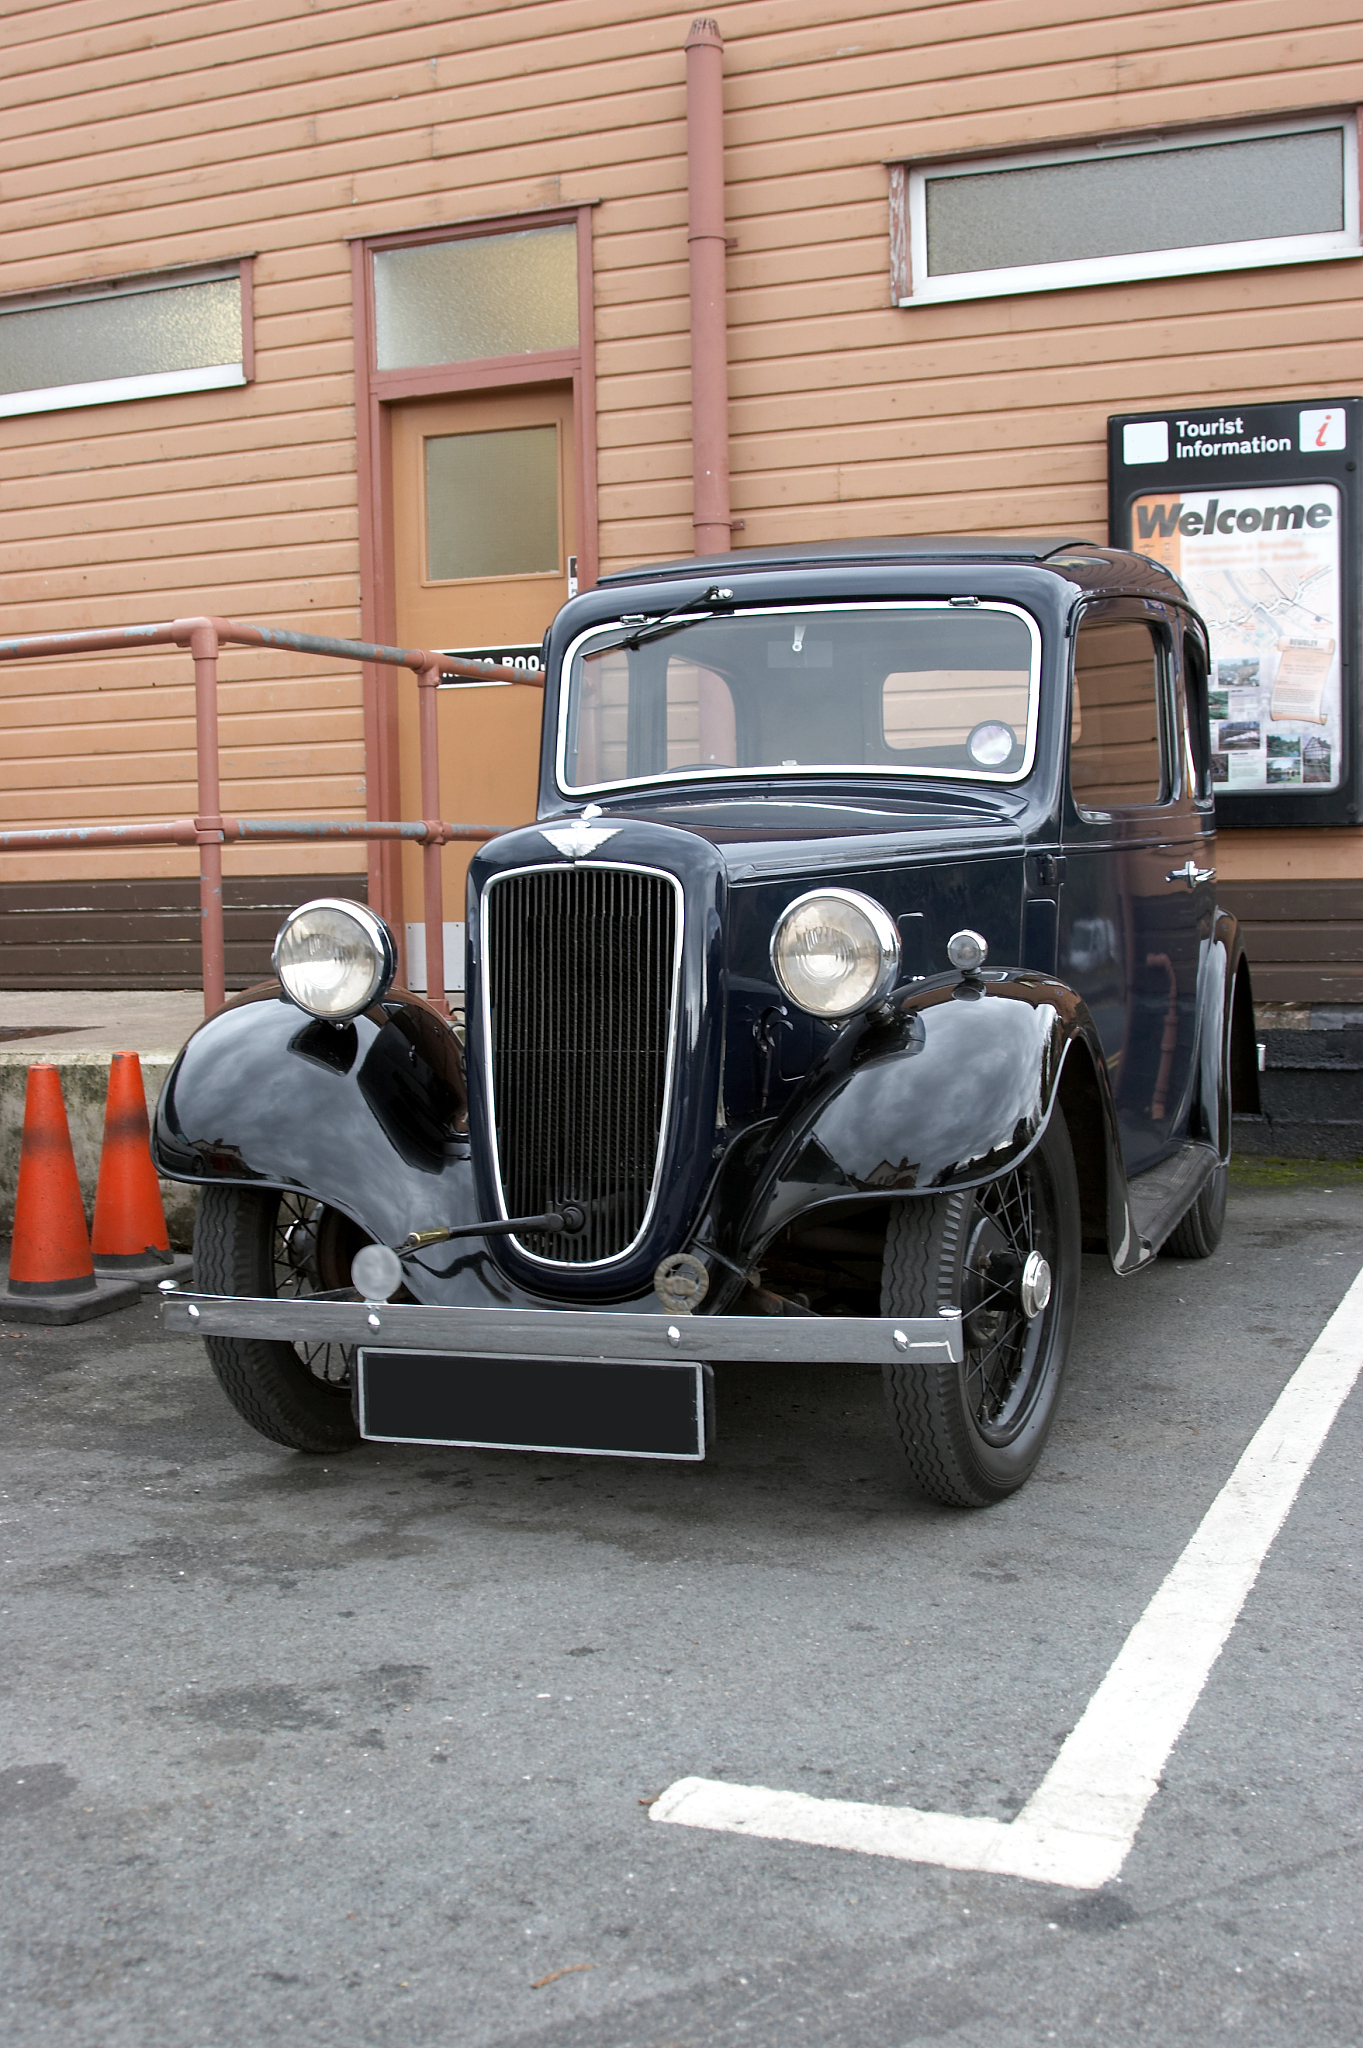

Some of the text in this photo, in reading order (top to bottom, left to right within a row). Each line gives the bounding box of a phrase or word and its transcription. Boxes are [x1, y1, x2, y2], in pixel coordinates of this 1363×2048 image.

[1176, 417, 1244, 438] Tourist
[1176, 435, 1292, 459] Information
[1136, 498, 1333, 539] Welcome
